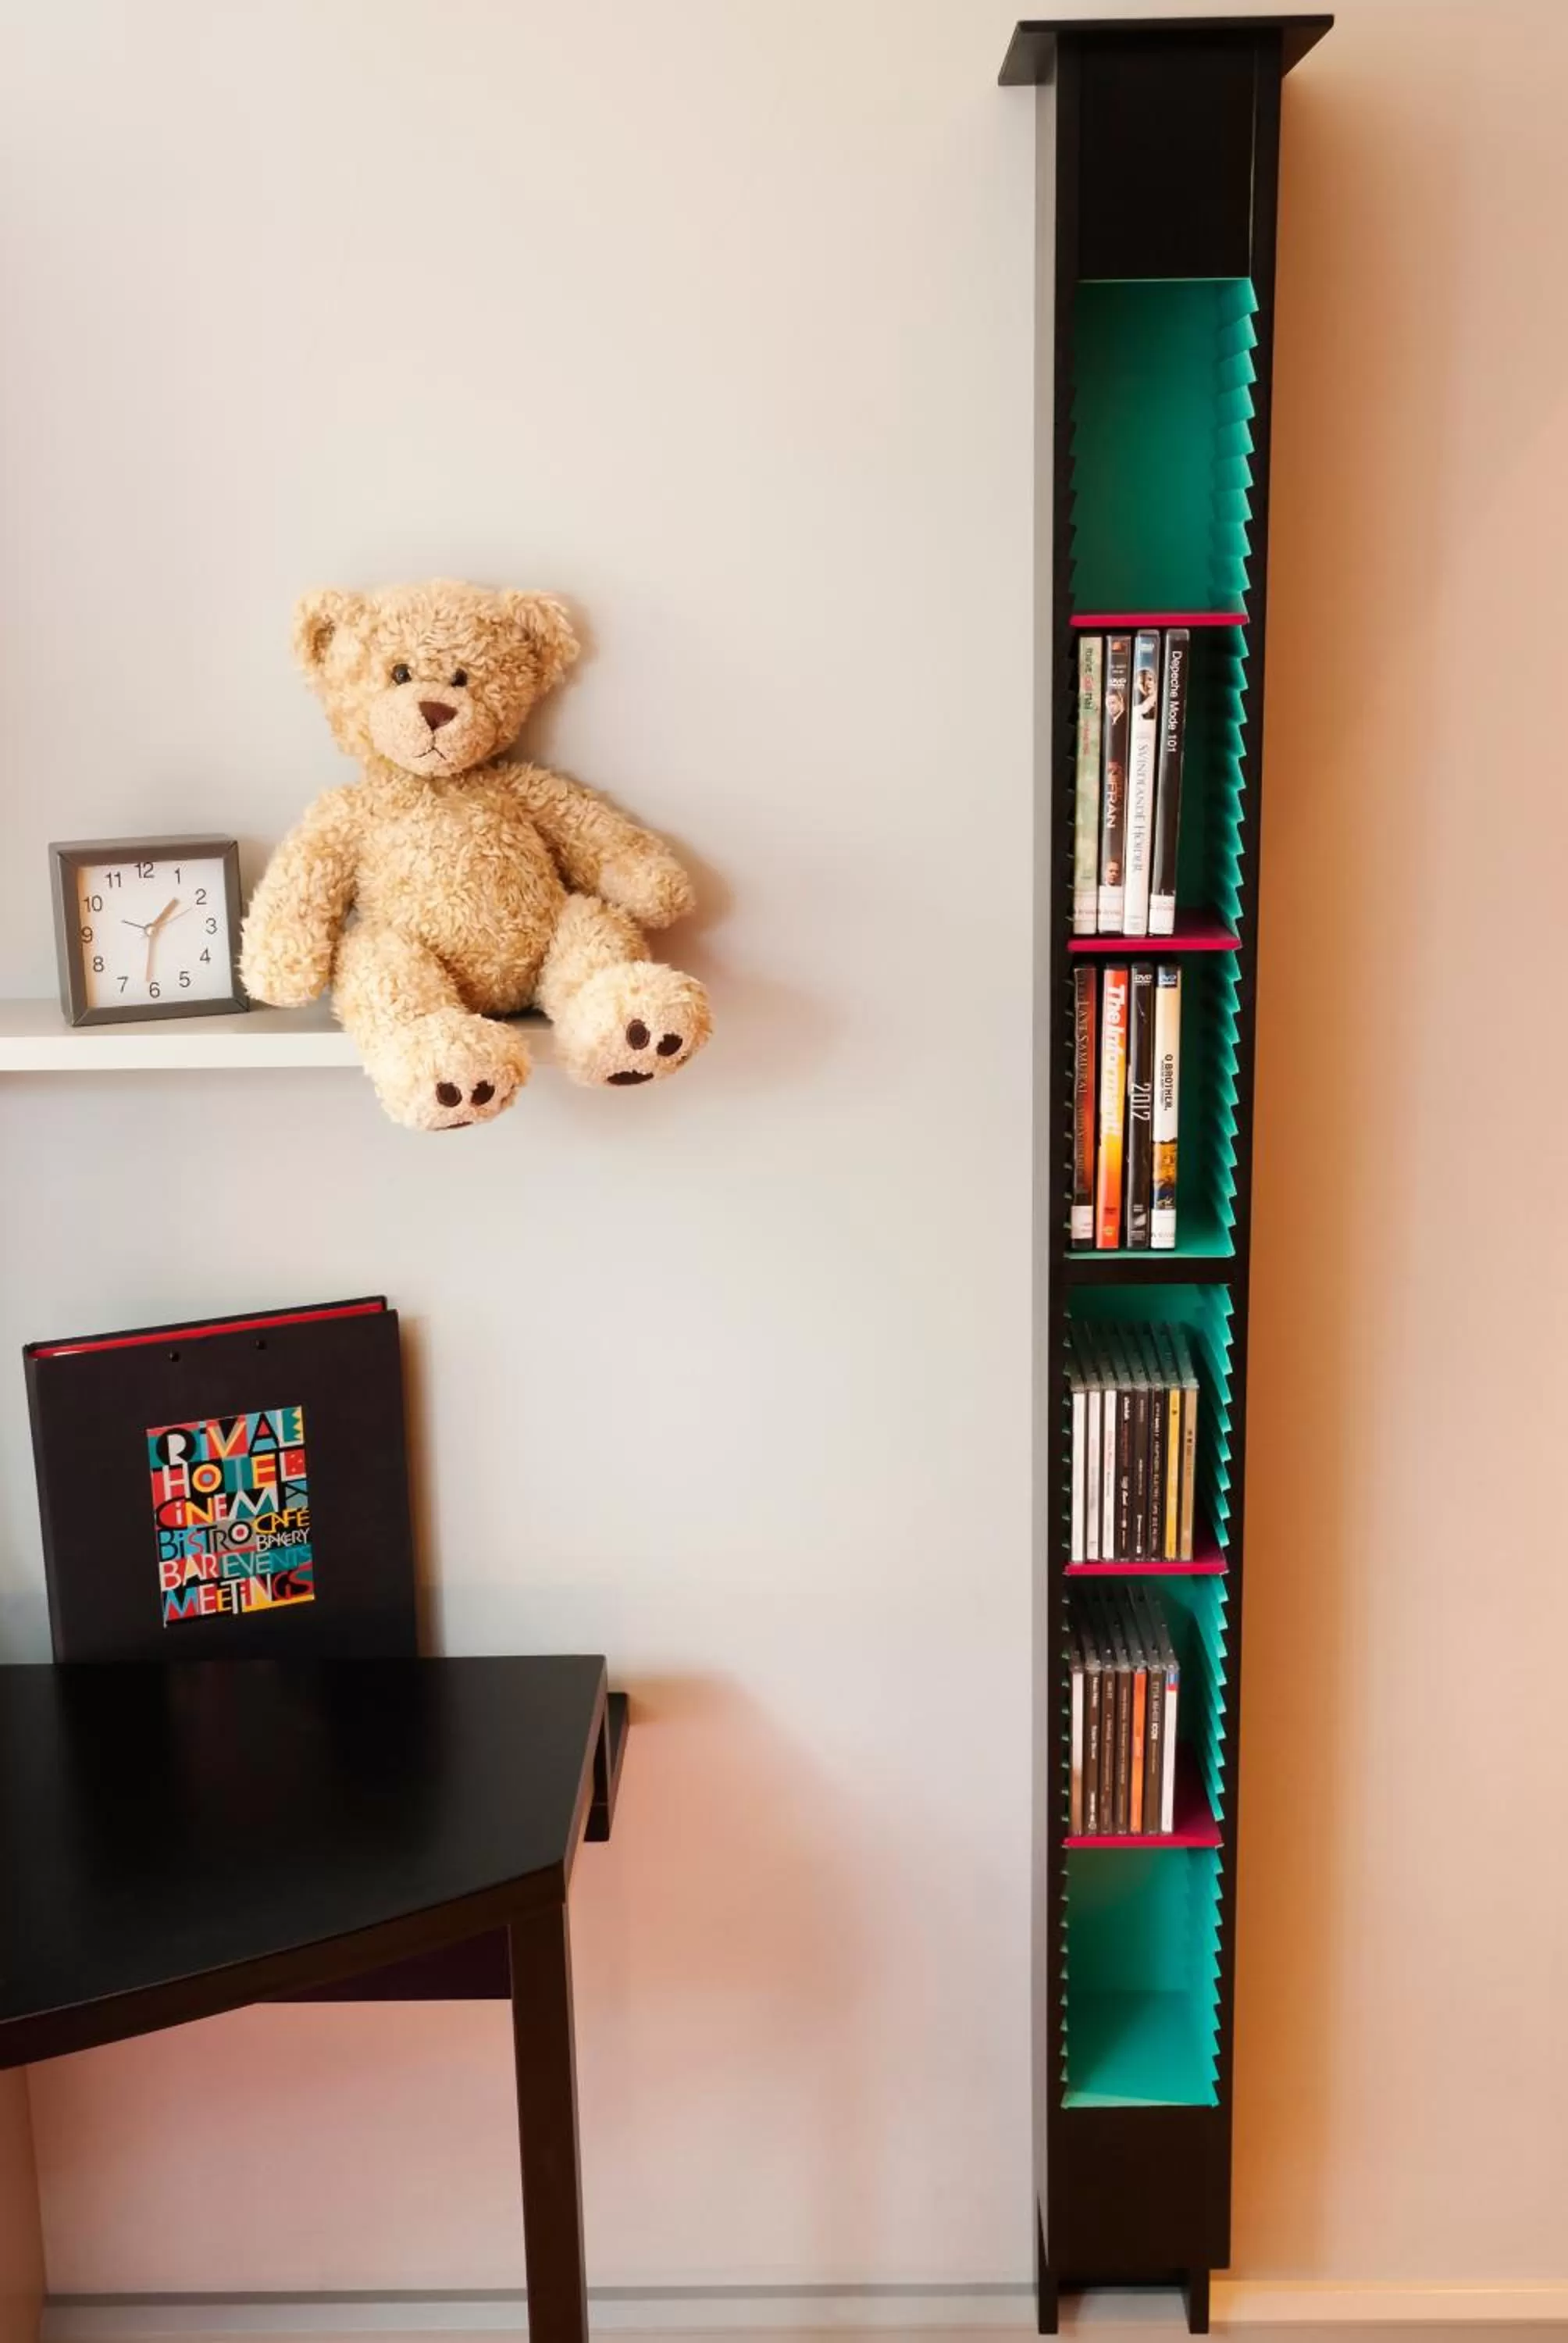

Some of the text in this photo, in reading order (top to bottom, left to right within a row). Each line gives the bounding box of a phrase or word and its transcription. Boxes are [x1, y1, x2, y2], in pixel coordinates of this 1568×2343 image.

[1167, 651, 1182, 753] Depeche Mode 101
[134, 861, 155, 879] 12
[175, 868, 181, 884] 1
[105, 872, 122, 888] 11
[83, 895, 102, 912] 10
[195, 888, 207, 905] 2
[81, 926, 93, 943] 9
[205, 918, 218, 935] 3
[93, 956, 104, 972] 8
[199, 948, 212, 965] 4
[117, 976, 129, 993] 7
[179, 971, 191, 988] 5
[149, 982, 160, 998] 6
[1107, 984, 1125, 1024] The
[1130, 1082, 1151, 1121] 2012
[162, 1449, 307, 1500] HOTEL
[252, 1507, 311, 1534] CAFÉ
[256, 1528, 311, 1553] BAKERY
[159, 1546, 312, 1592] BAR EVENTS
